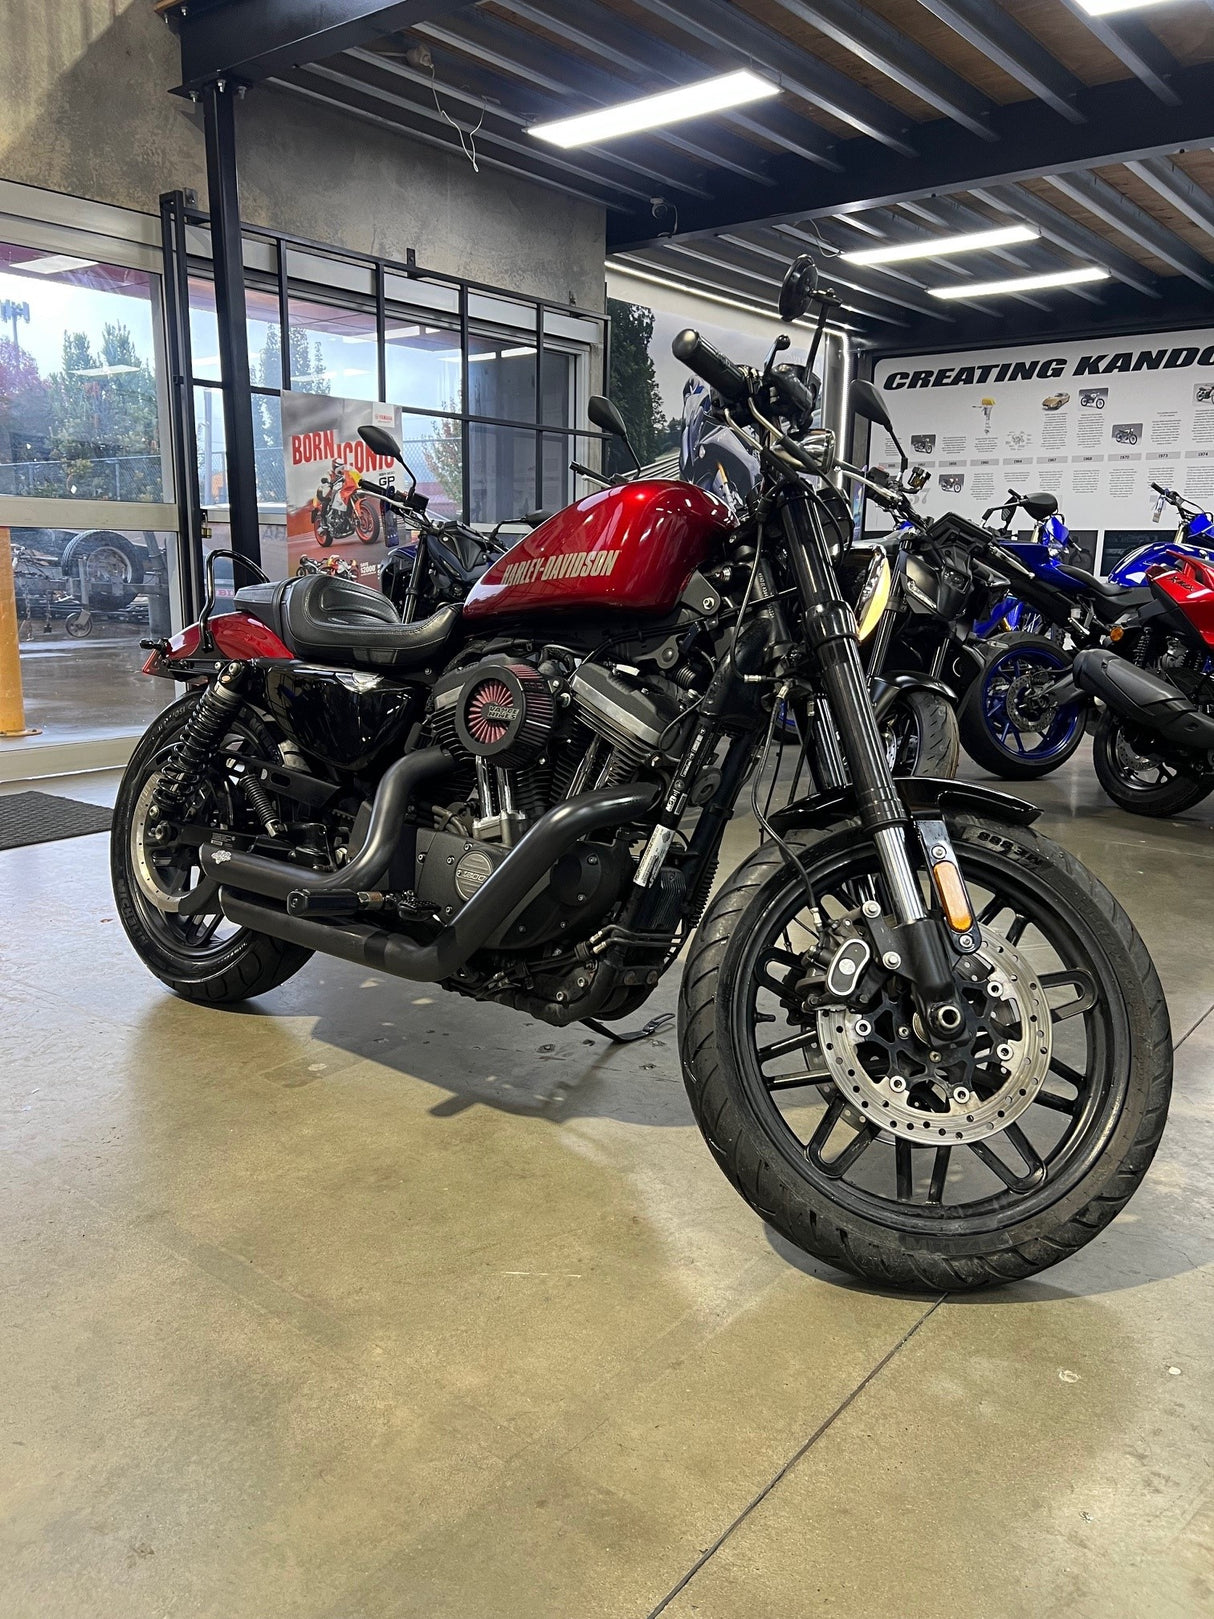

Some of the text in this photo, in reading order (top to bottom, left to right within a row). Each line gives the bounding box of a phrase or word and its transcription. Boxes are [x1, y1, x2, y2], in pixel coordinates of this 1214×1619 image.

[884, 358, 1068, 391] CREATING
[292, 429, 335, 465] BORN
[379, 476, 395, 486] GP
[501, 550, 621, 586] HARLEY-DAVIDSON
